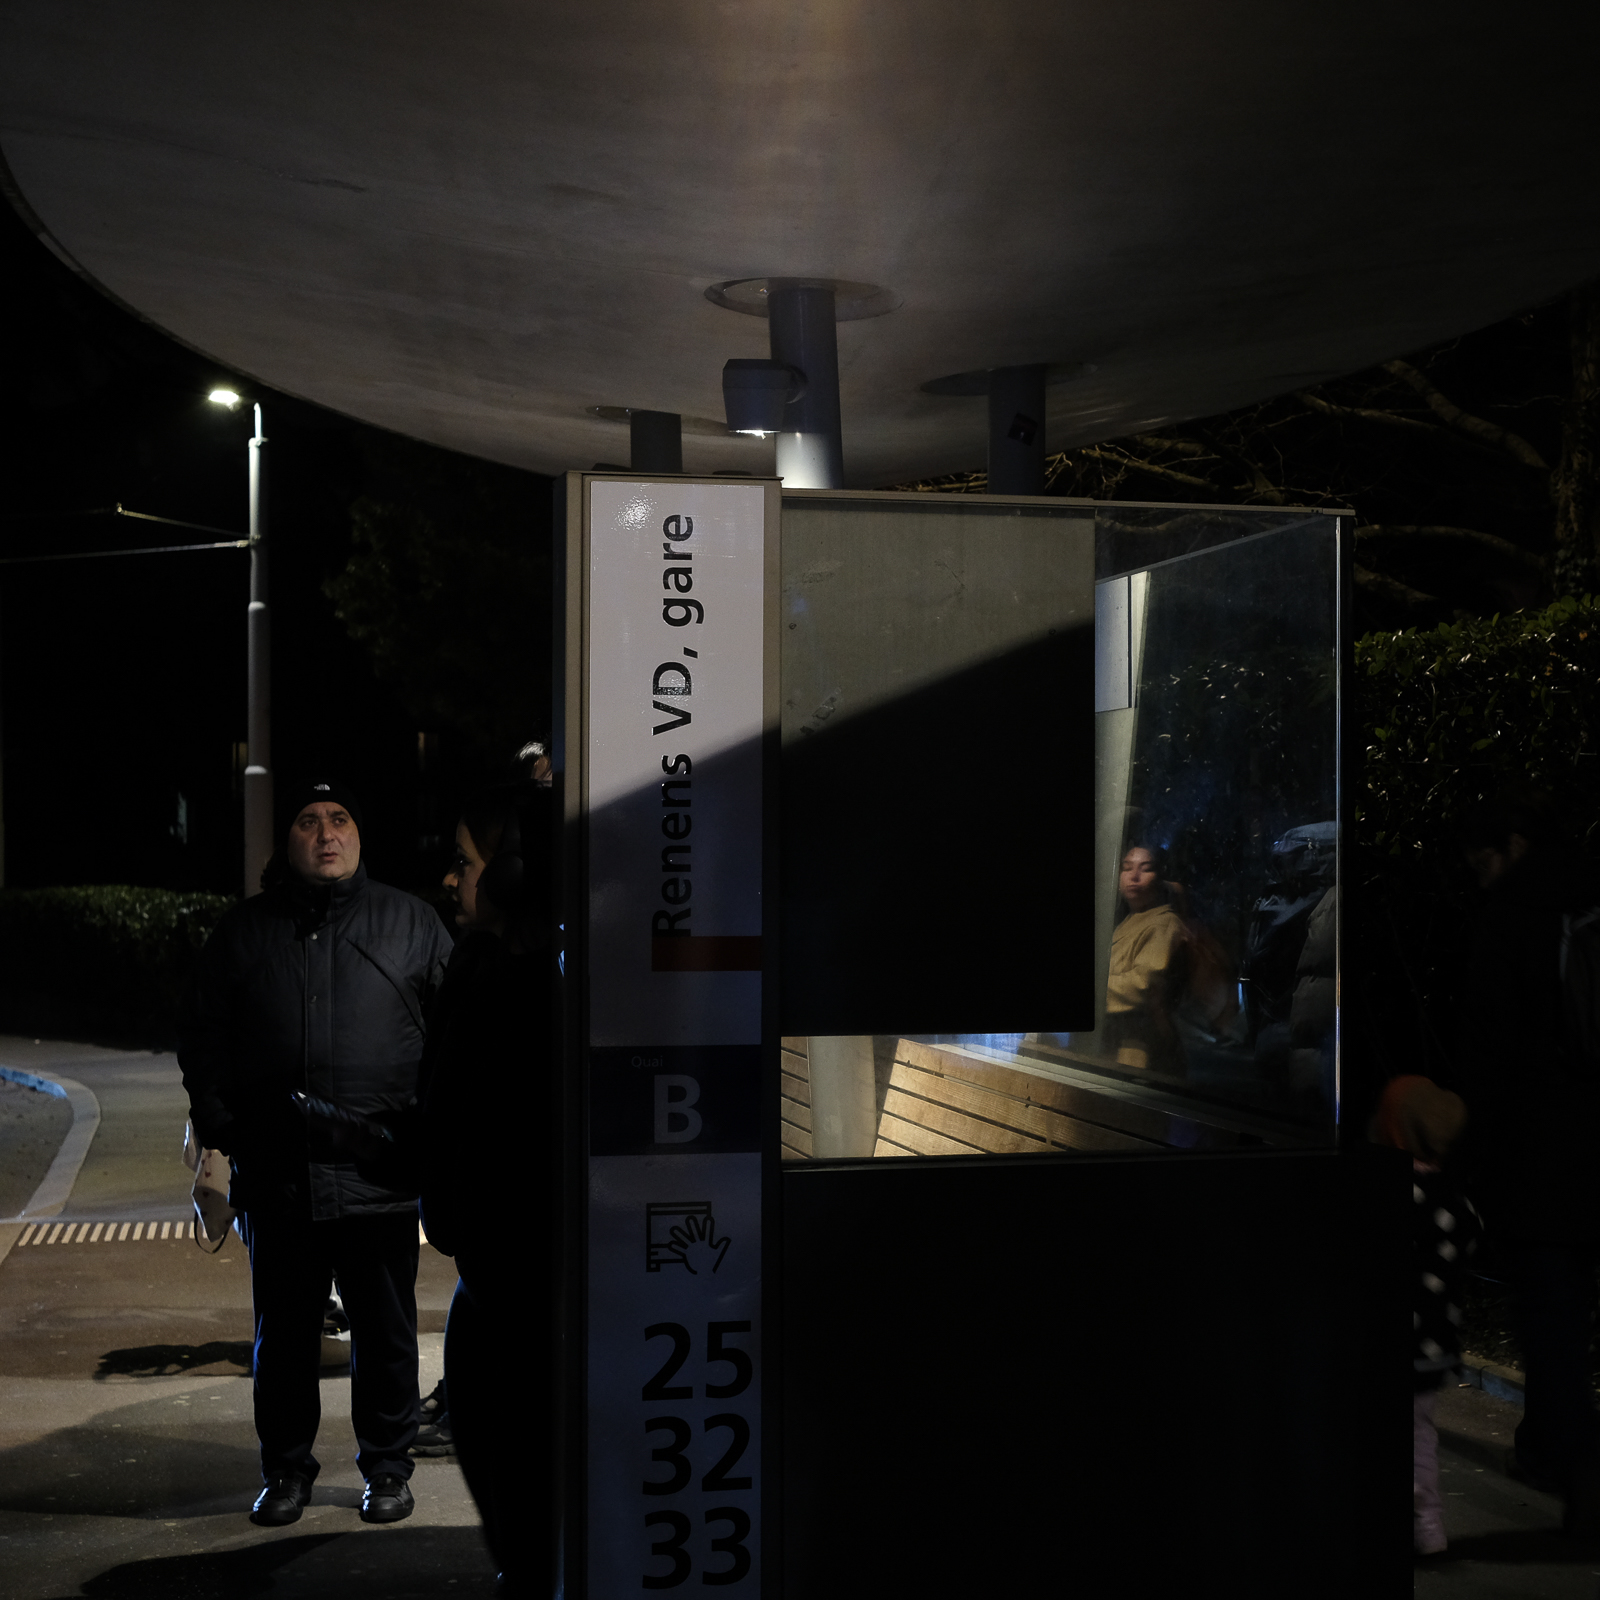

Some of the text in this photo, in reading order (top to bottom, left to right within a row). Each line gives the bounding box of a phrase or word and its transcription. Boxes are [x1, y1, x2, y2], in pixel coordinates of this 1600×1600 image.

[652, 513, 704, 938] Renens VD, gare
[630, 1055, 664, 1070] Quai
[653, 1074, 703, 1144] B
[642, 1321, 753, 1401] 25
[642, 1413, 753, 1495] 32
[642, 1507, 752, 1590] 33
